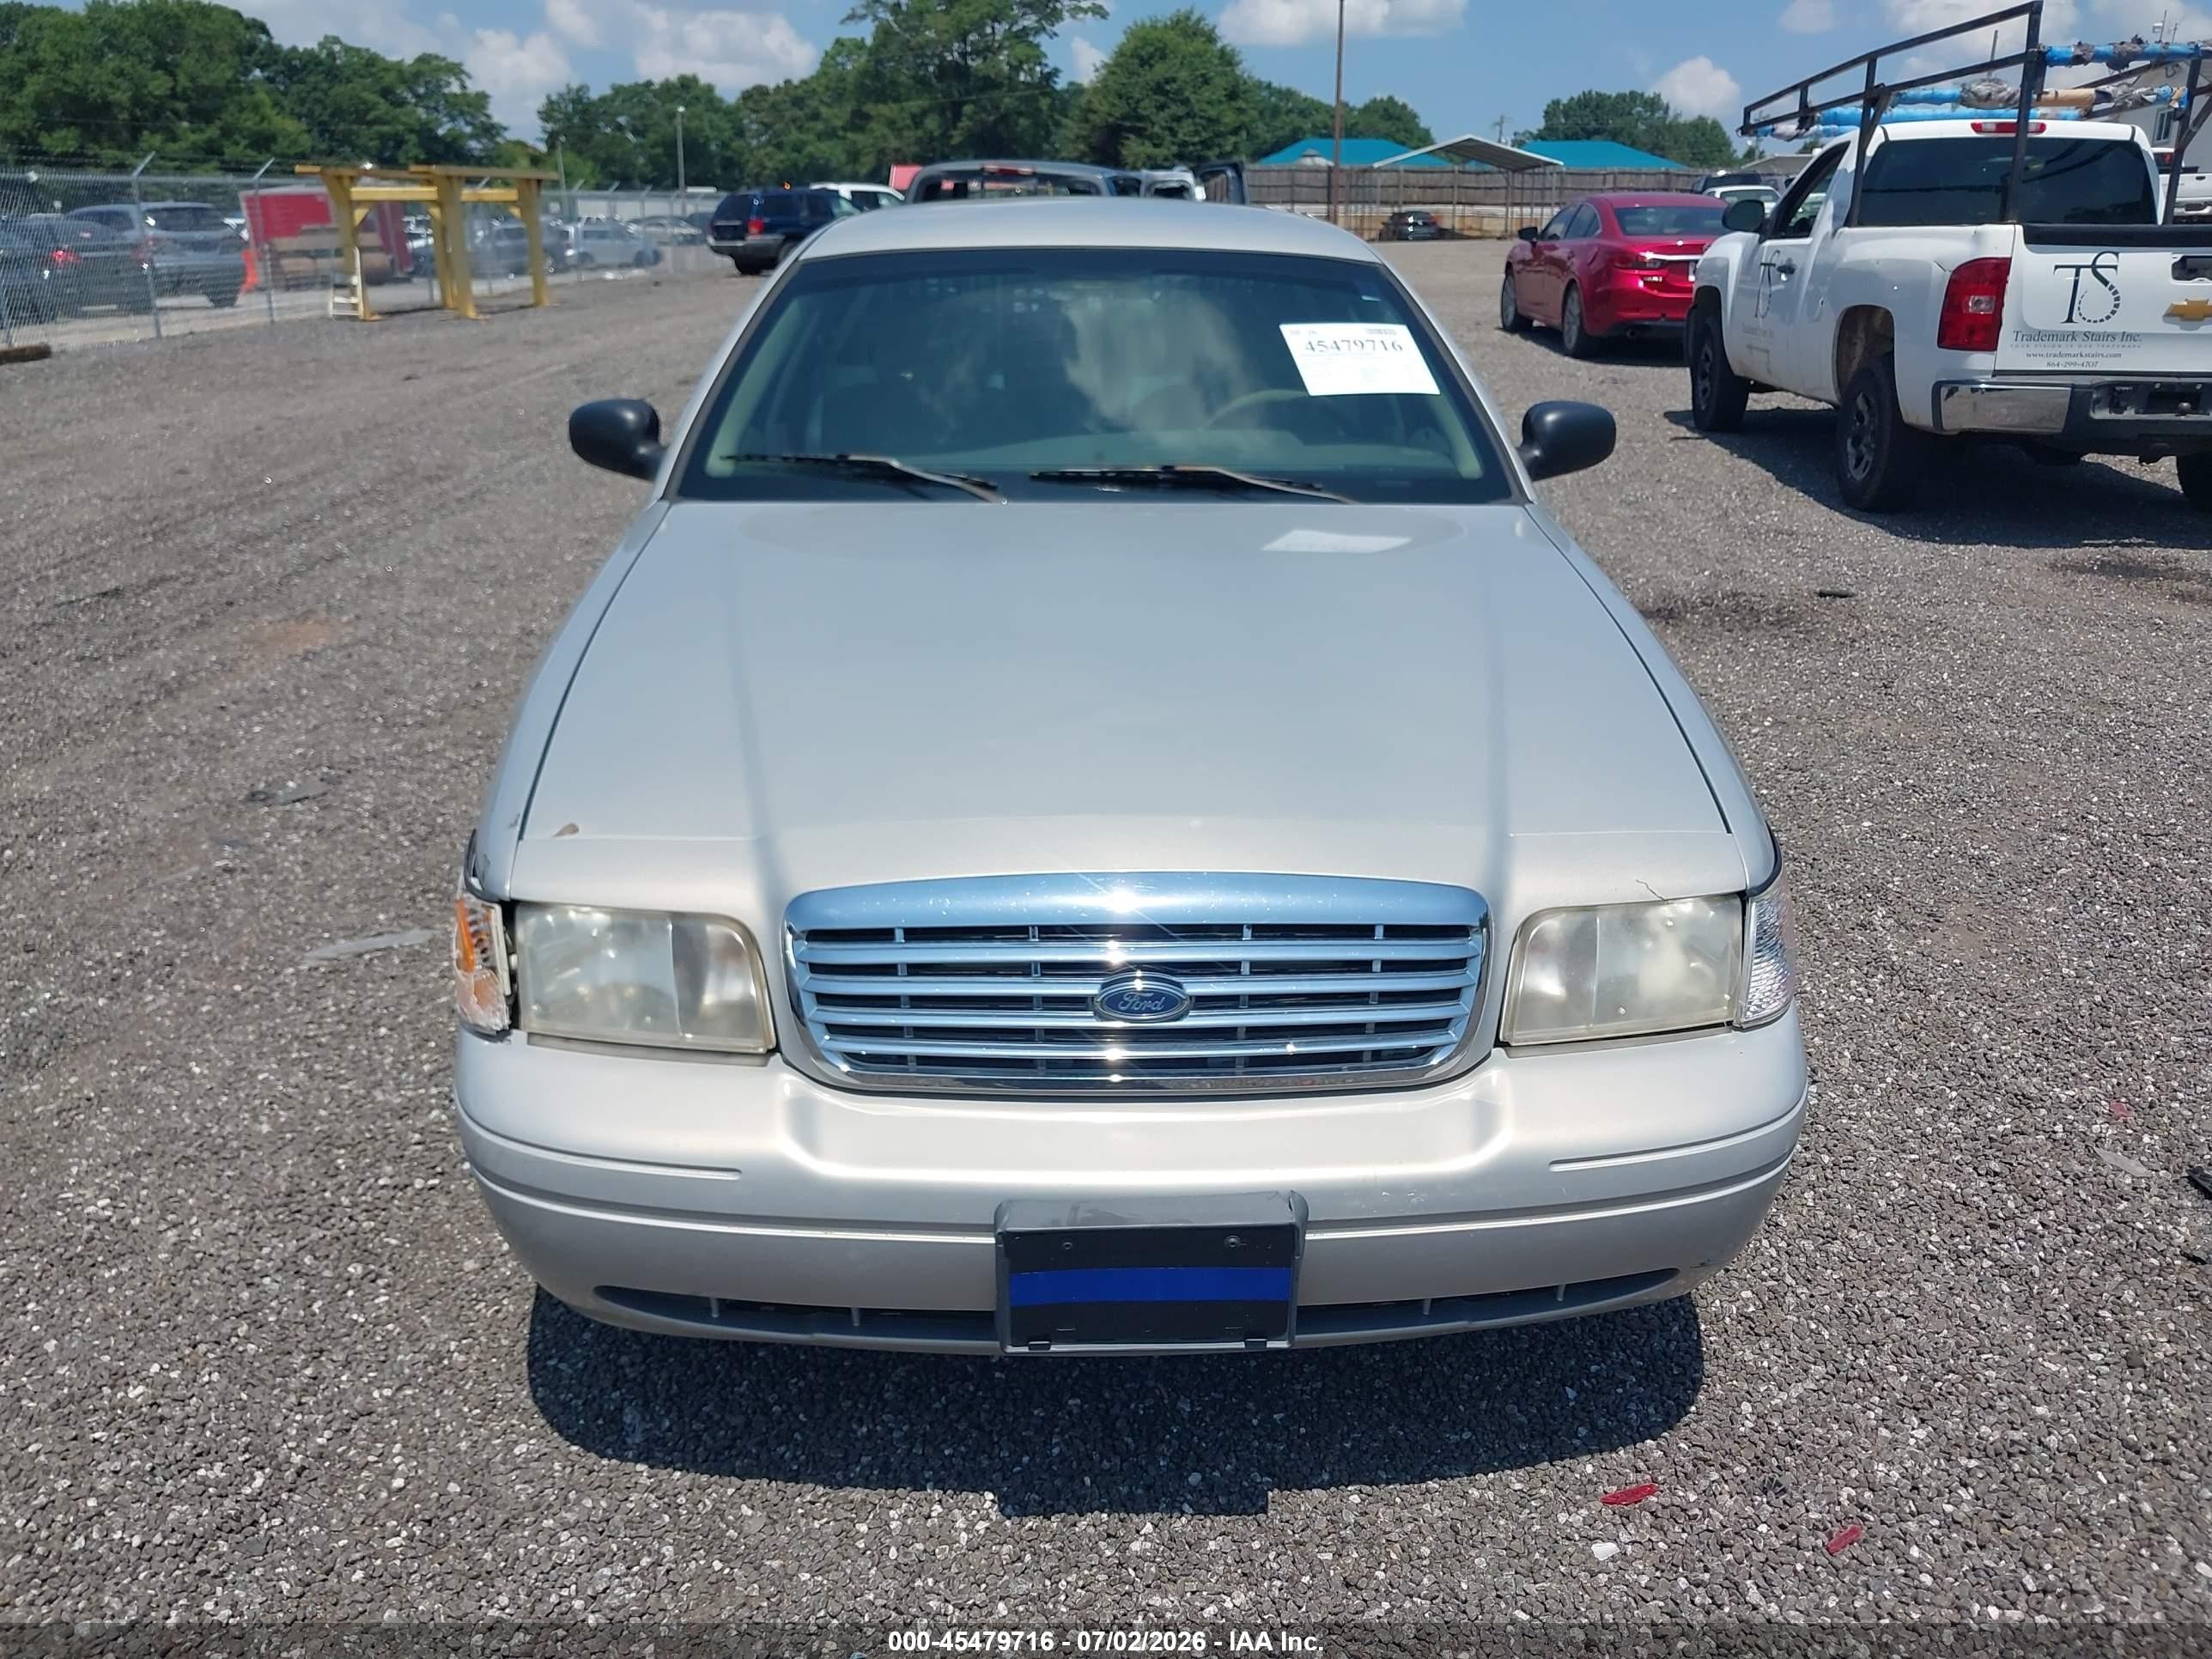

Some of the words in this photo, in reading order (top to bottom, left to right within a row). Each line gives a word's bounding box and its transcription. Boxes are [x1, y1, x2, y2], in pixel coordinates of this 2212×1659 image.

[2052, 251, 2121, 324] TS
[2013, 330, 2077, 343] Trademark
[2081, 331, 2116, 343] Stairs
[2120, 331, 2142, 343] Inc.
[1305, 339, 1404, 353] 45479716
[2026, 350, 2122, 359] www.trademarkstairs.com
[1118, 992, 1166, 1011] Ford
